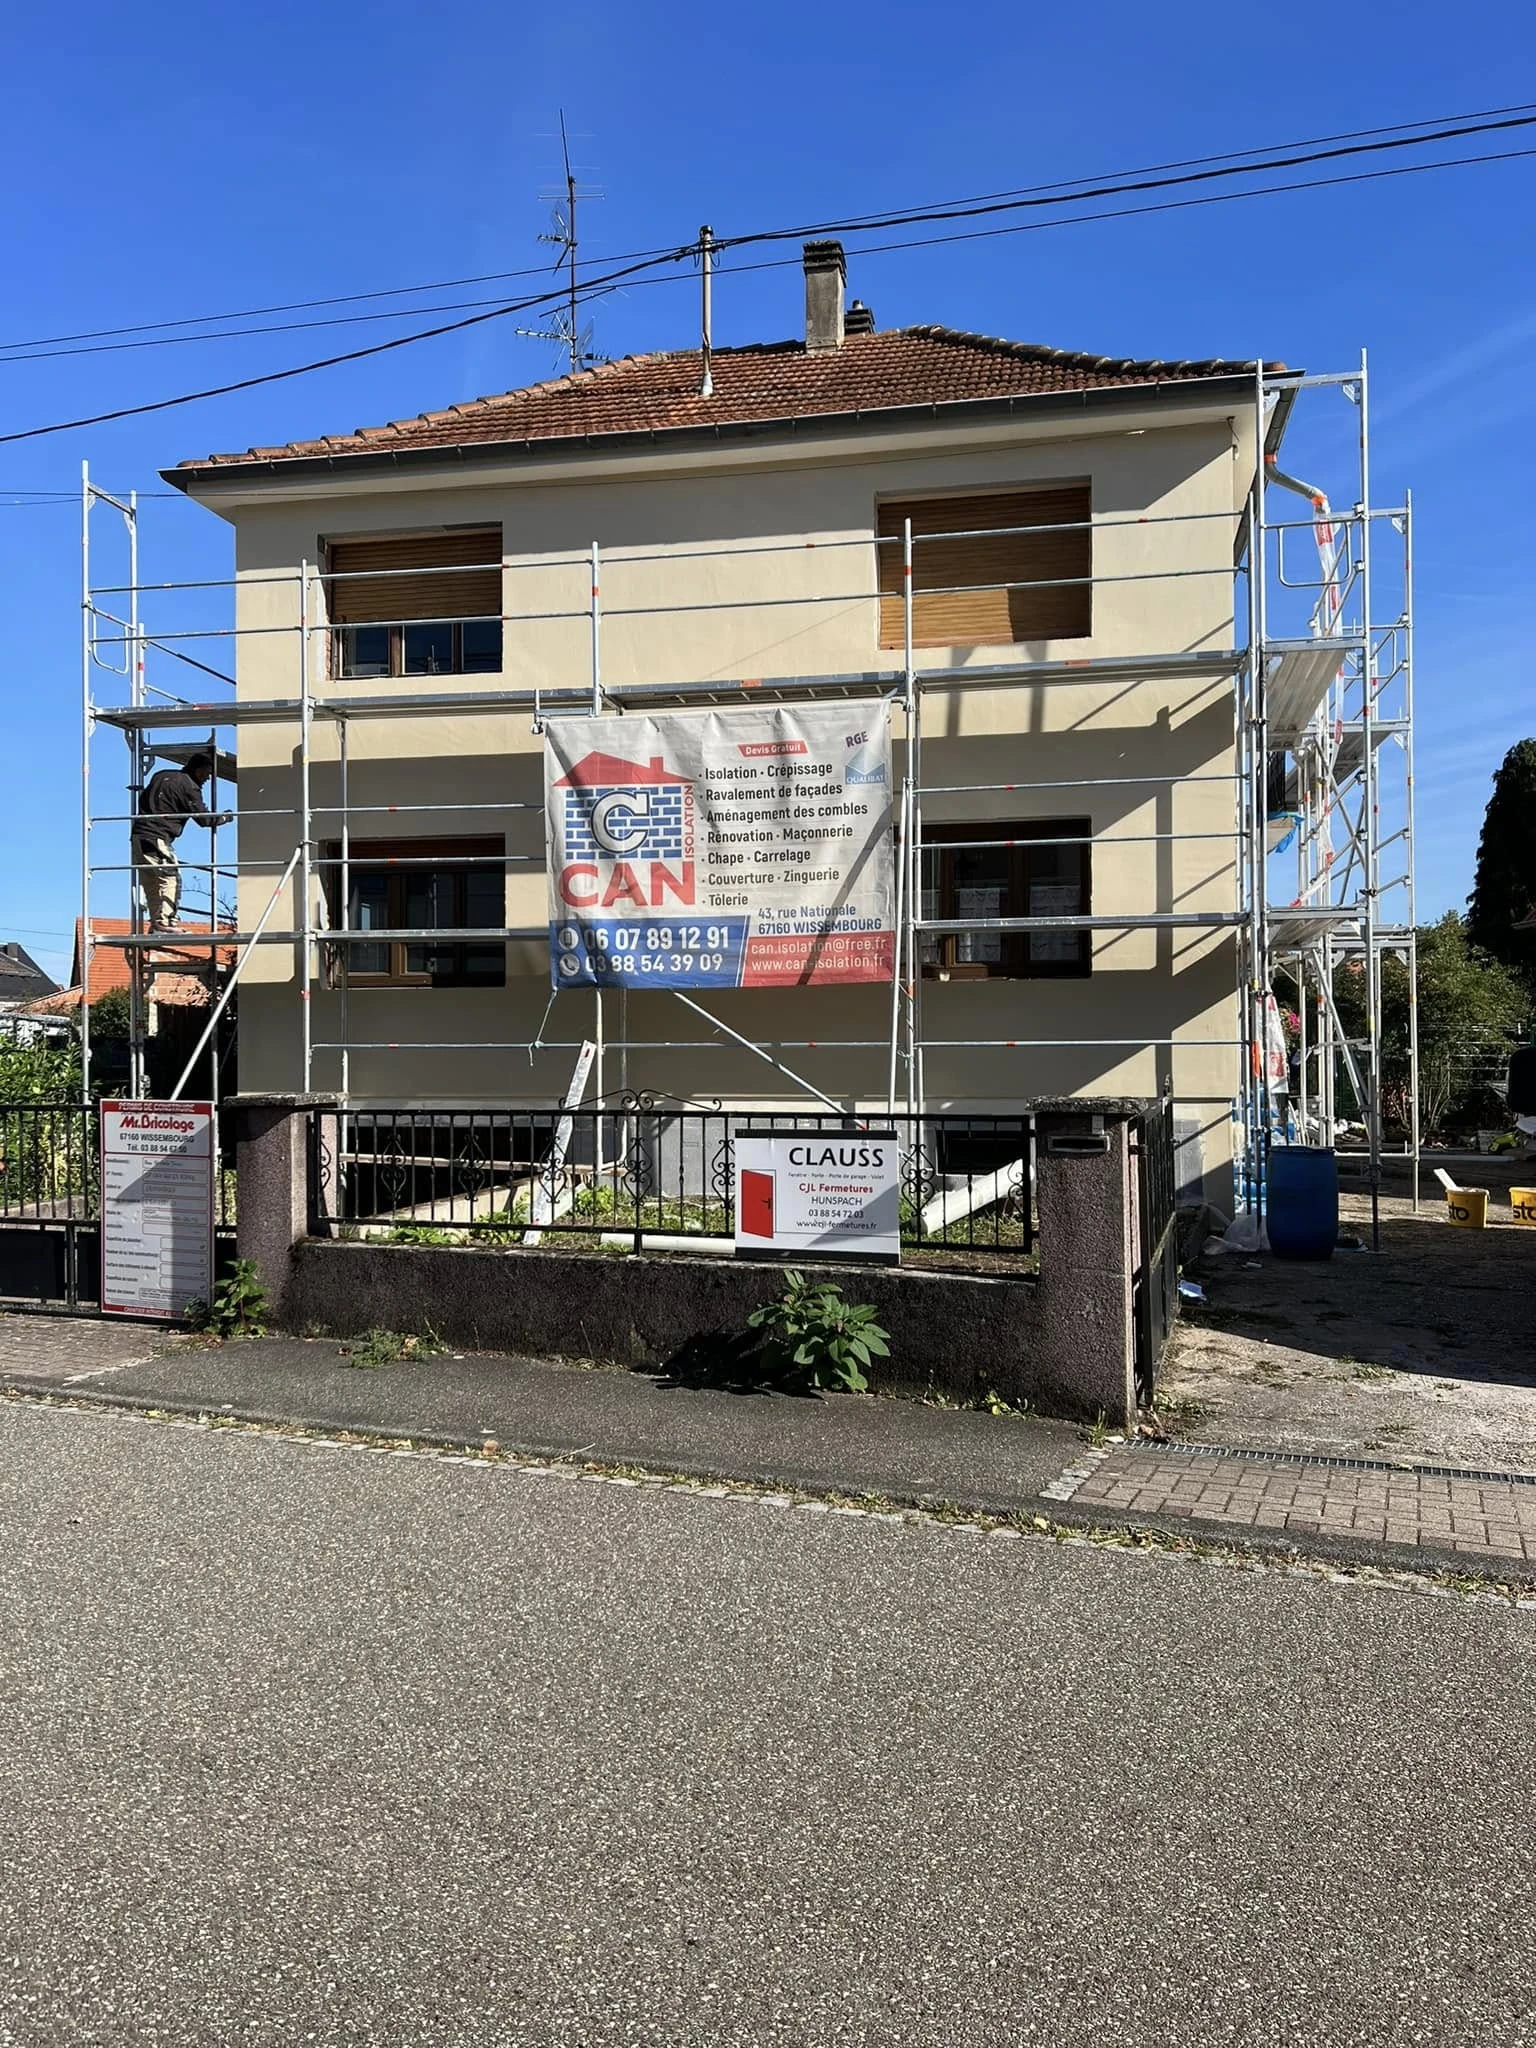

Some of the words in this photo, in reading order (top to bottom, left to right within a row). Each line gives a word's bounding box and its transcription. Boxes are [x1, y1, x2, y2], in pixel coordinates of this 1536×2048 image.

[845, 731, 868, 748] RGE
[746, 745, 769, 755] Devis
[771, 743, 801, 753] Gratuit
[705, 766, 757, 780] Isolation
[767, 763, 833, 780] Crépissage
[706, 785, 775, 800] Ravalement
[778, 784, 791, 797] de
[795, 783, 843, 800] façades
[707, 806, 790, 823] Aménagement
[794, 804, 815, 818] des
[818, 803, 868, 817] combles
[684, 785, 694, 859] ISOLATION
[708, 828, 773, 843] Rénovation
[783, 825, 853, 842] Maçonnerie
[708, 851, 744, 866] Chape
[754, 849, 811, 863] Carrelage
[559, 861, 696, 907] CAN
[708, 871, 774, 886] Couverture
[784, 868, 839, 884] Zinguerie
[709, 893, 748, 906] Tôlerie
[758, 907, 775, 919] 43,
[778, 908, 797, 918] rue
[800, 904, 856, 918] Nationale
[758, 922, 790, 934] 67160
[794, 917, 882, 933] WISSEMBOURG
[584, 929, 608, 950] 06
[615, 928, 640, 950] 07
[646, 927, 672, 950] 89
[678, 926, 700, 949] 12
[707, 926, 729, 948] 91
[751, 937, 887, 956] can.isolation@free.fr
[585, 955, 607, 972] 03
[612, 955, 635, 972] 88
[641, 954, 664, 972] 54
[670, 954, 693, 971] 39
[700, 953, 722, 971] 09
[752, 955, 885, 971] www.can-isolation.fr
[118, 1102, 143, 1110] PERMIS
[143, 1103, 153, 1111] DE
[140, 1133, 195, 1143] WISSEMBOURG
[789, 1147, 884, 1167] CLAUSS
[799, 1183, 816, 1193] CJL
[819, 1183, 873, 1193] Fermetures
[811, 1196, 862, 1206] HUNSPACH
[808, 1209, 818, 1217] 03
[820, 1209, 830, 1217] 88
[831, 1209, 841, 1217] 54
[843, 1210, 852, 1218] 72
[854, 1210, 864, 1218] 03
[796, 1220, 878, 1230] www.cjl-fermetures.fr
